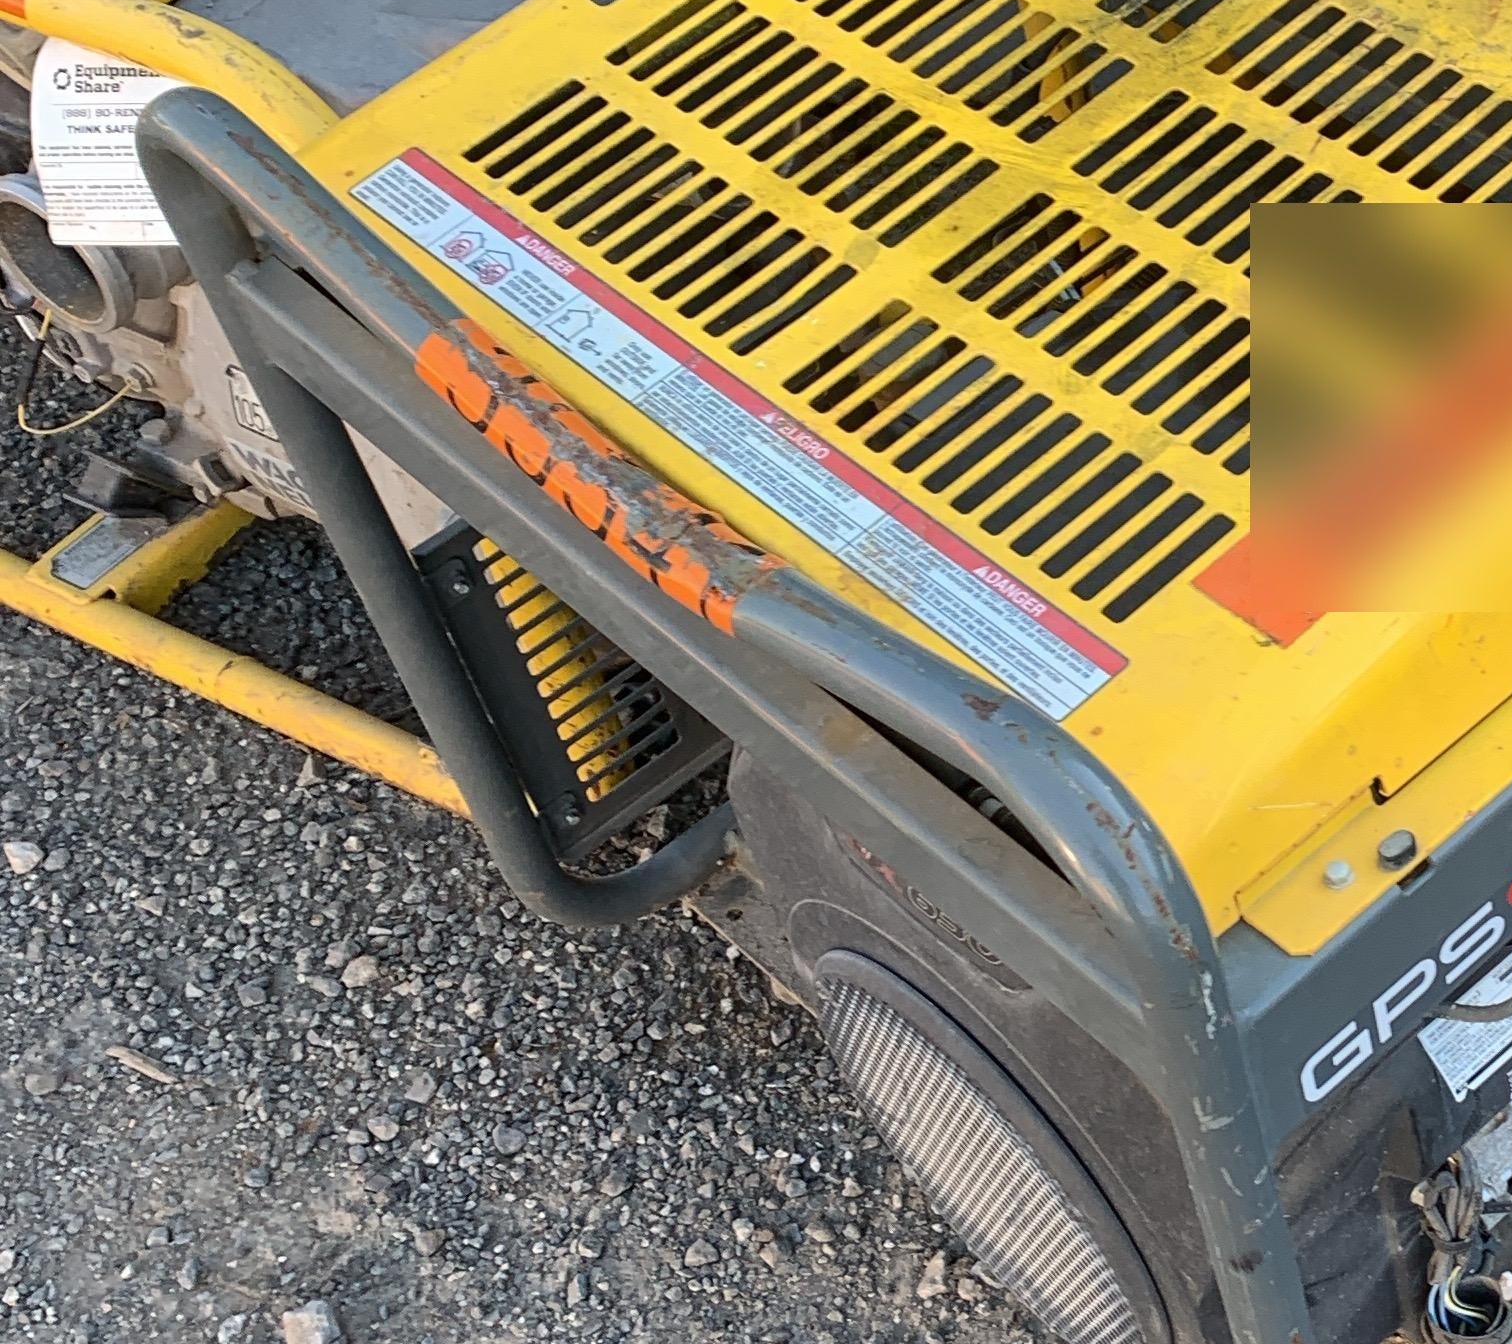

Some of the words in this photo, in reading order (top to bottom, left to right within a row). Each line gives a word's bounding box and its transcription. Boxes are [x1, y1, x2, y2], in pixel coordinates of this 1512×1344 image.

[74, 80, 121, 94] Share
[95, 109, 144, 118] 80-REN
[66, 125, 101, 134] THINK
[105, 125, 135, 134] SAFE
[524, 236, 576, 276] DANGER
[986, 569, 1048, 618] DANGER
